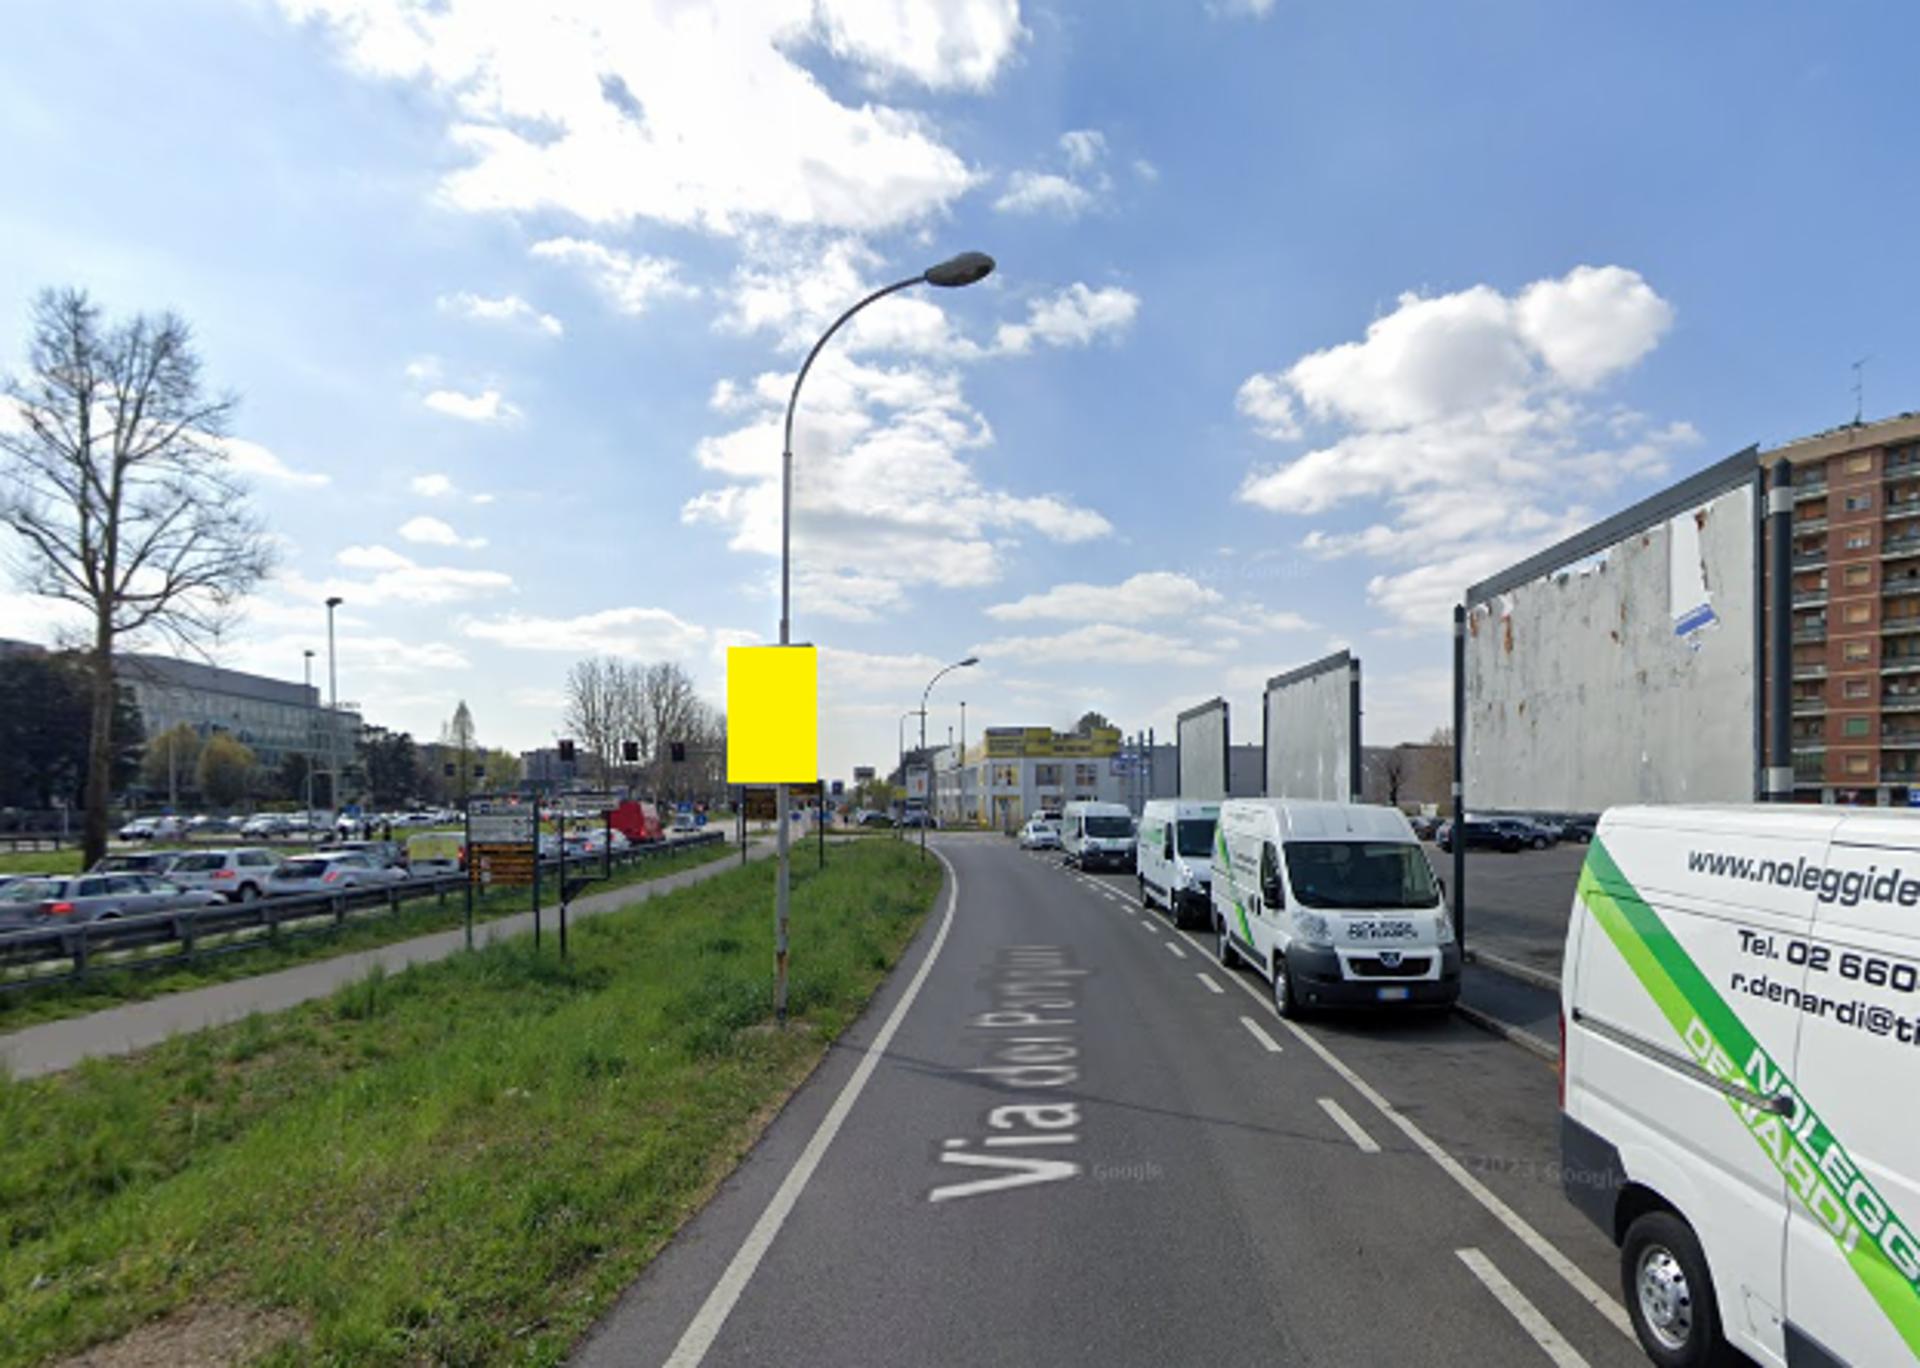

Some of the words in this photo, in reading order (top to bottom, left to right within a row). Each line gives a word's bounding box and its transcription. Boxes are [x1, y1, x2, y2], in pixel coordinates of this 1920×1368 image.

[1688, 849, 1920, 907] www.noleggide
[1738, 929, 1779, 960] Tel.
[1786, 940, 1831, 972] 02
[1685, 1016, 1734, 1078] DE
